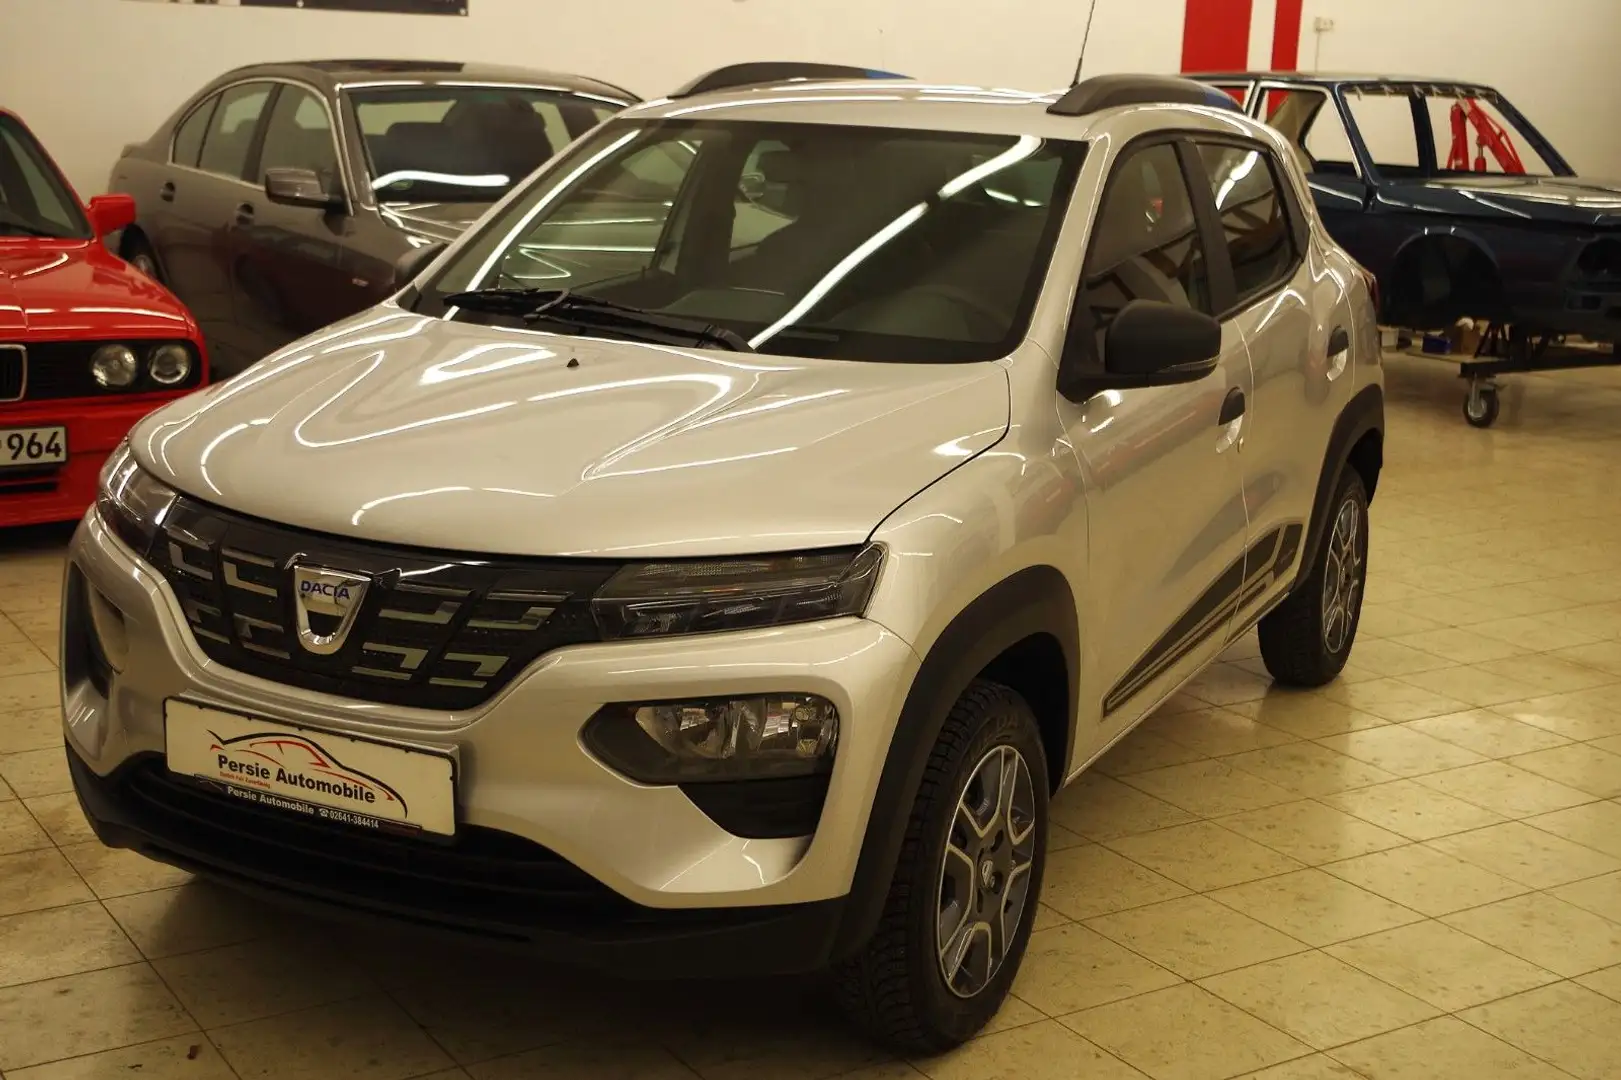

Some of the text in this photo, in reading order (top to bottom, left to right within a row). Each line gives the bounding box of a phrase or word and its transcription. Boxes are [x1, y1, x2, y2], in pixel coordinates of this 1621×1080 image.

[7, 431, 62, 460] 964
[301, 580, 350, 600] DACIA
[218, 754, 270, 779] Persie
[276, 768, 375, 803] Automobile
[227, 786, 257, 800] Persie
[260, 795, 314, 815] Automobile
